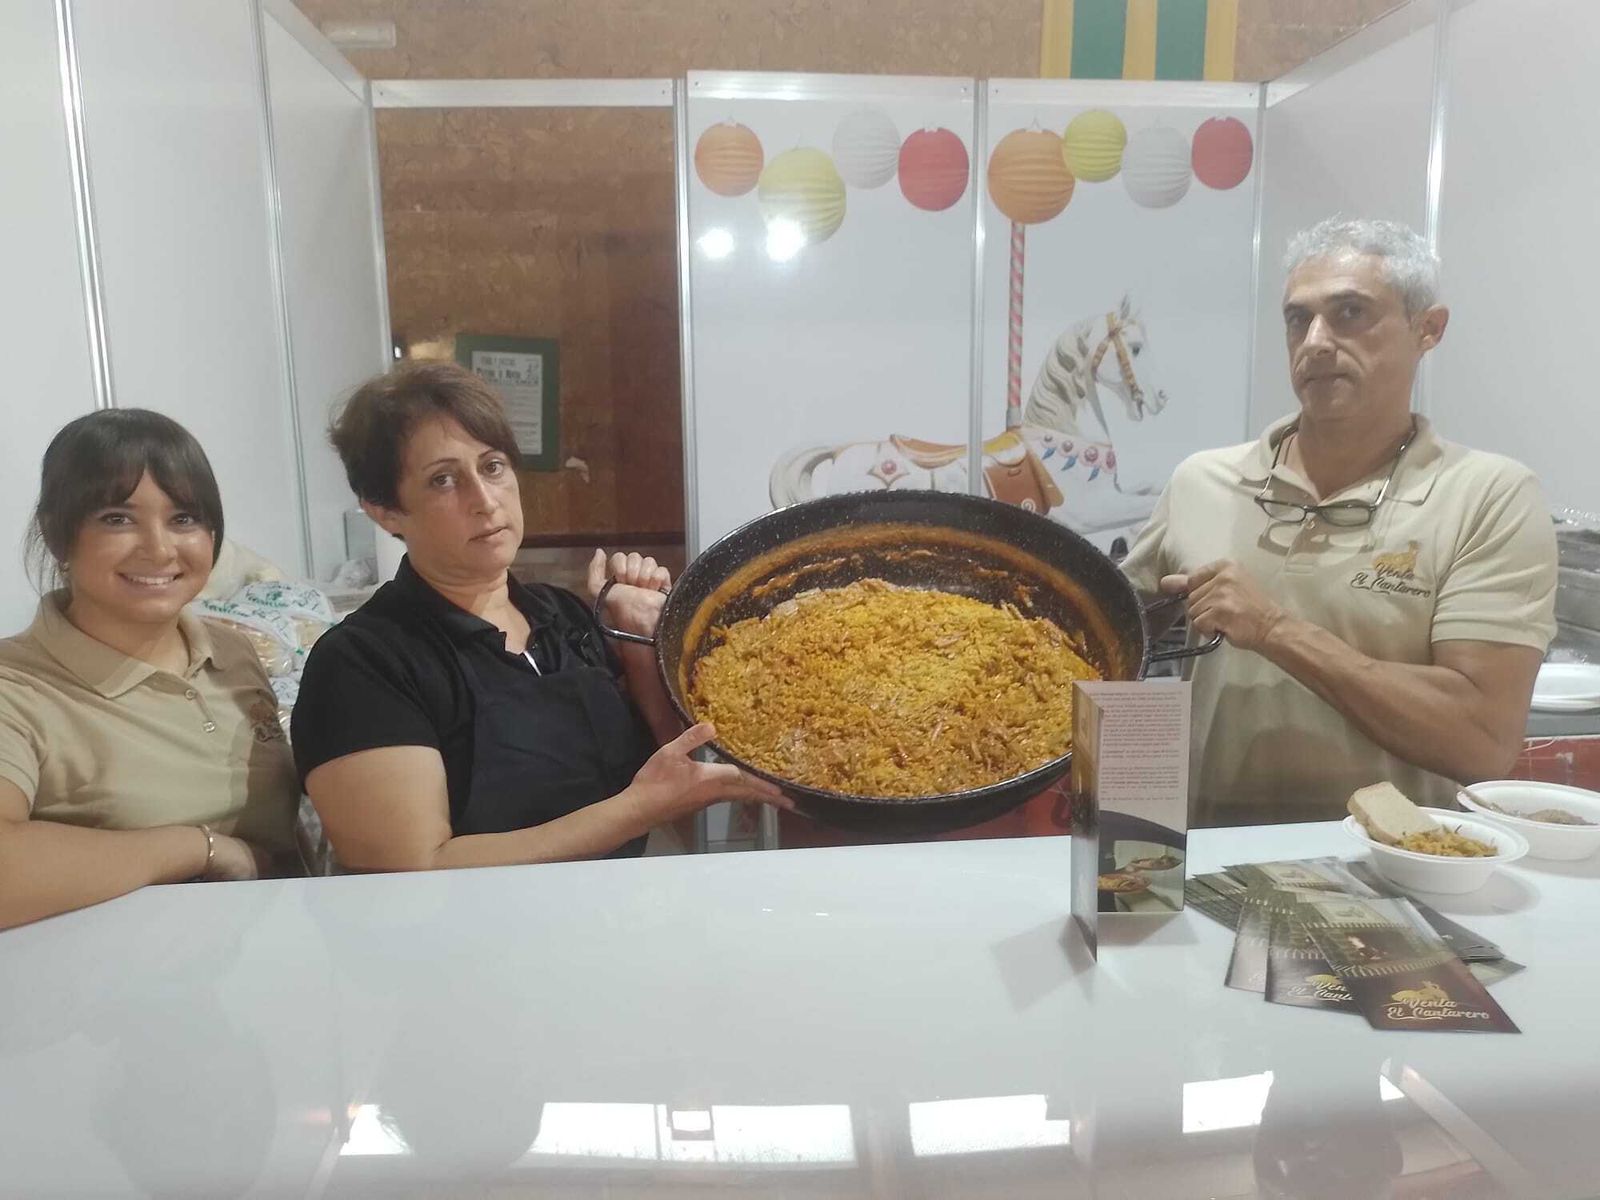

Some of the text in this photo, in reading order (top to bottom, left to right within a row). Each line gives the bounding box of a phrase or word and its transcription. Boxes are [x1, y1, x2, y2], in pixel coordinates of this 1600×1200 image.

[1374, 561, 1416, 580] Venta
[1350, 571, 1432, 599] El Cantarero
[1311, 981, 1347, 992] Ven
[1402, 998, 1458, 1009] Venta
[1386, 1006, 1490, 1020] El Cantarero
